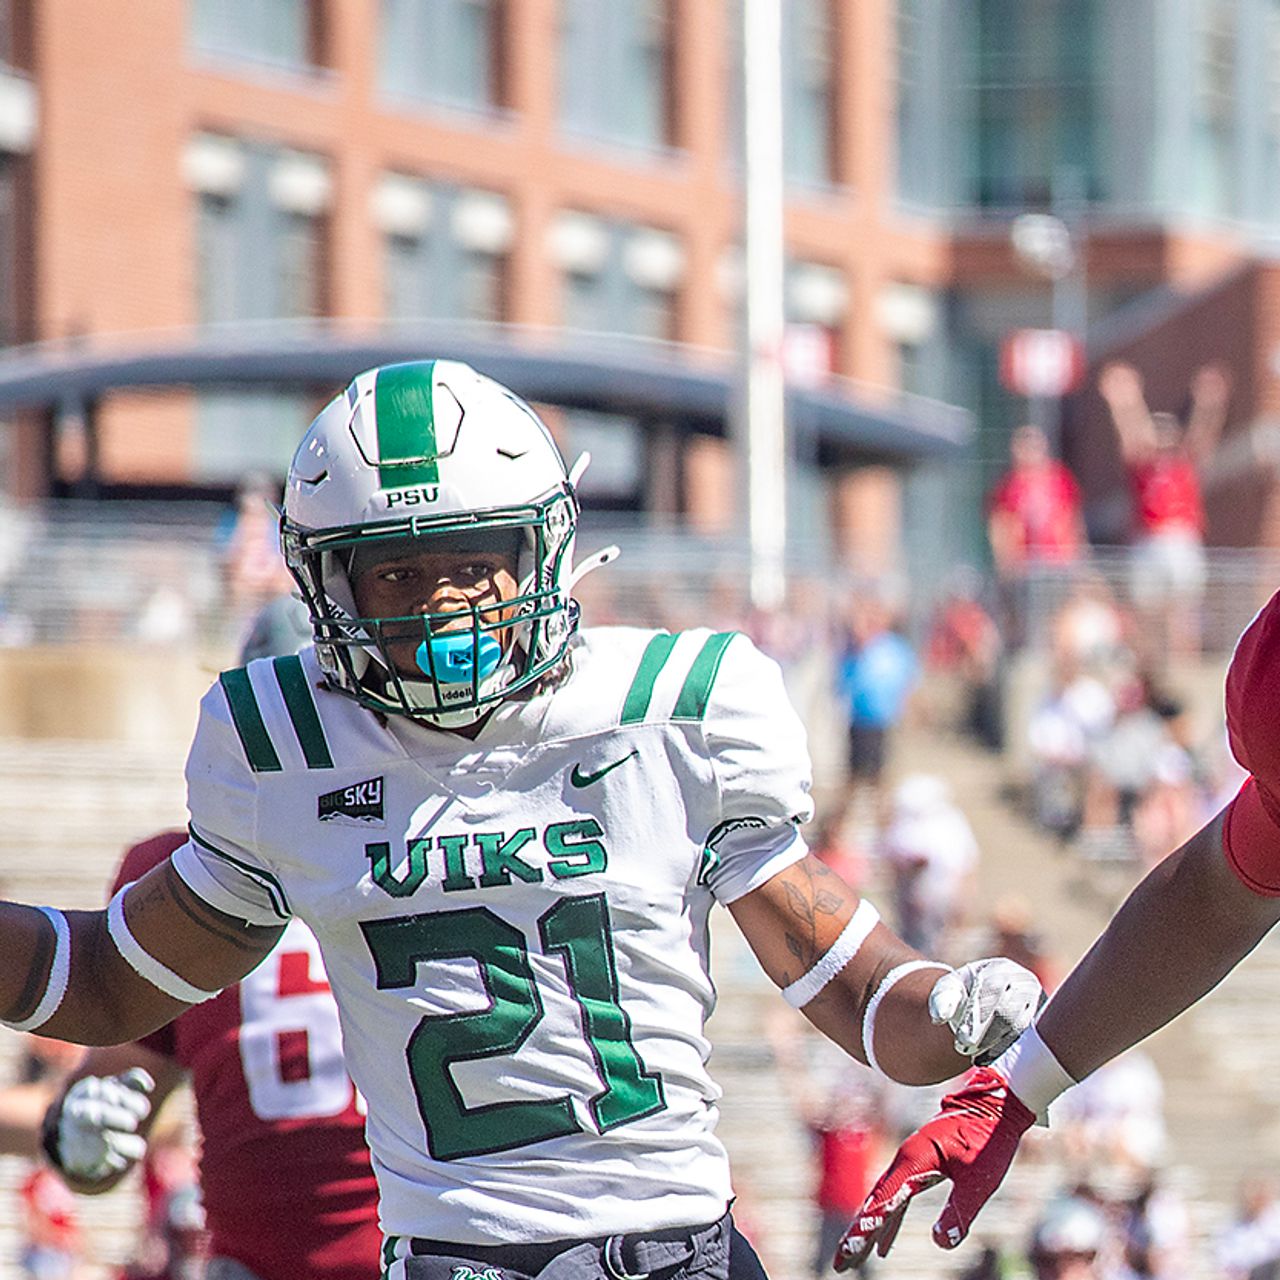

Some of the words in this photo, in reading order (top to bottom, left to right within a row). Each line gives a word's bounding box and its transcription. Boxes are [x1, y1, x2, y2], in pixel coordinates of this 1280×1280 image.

[386, 487, 439, 508] PSU
[442, 687, 473, 700] iddell
[344, 780, 381, 806] SKY
[365, 818, 608, 899] VIKS
[360, 892, 667, 1161] 21
